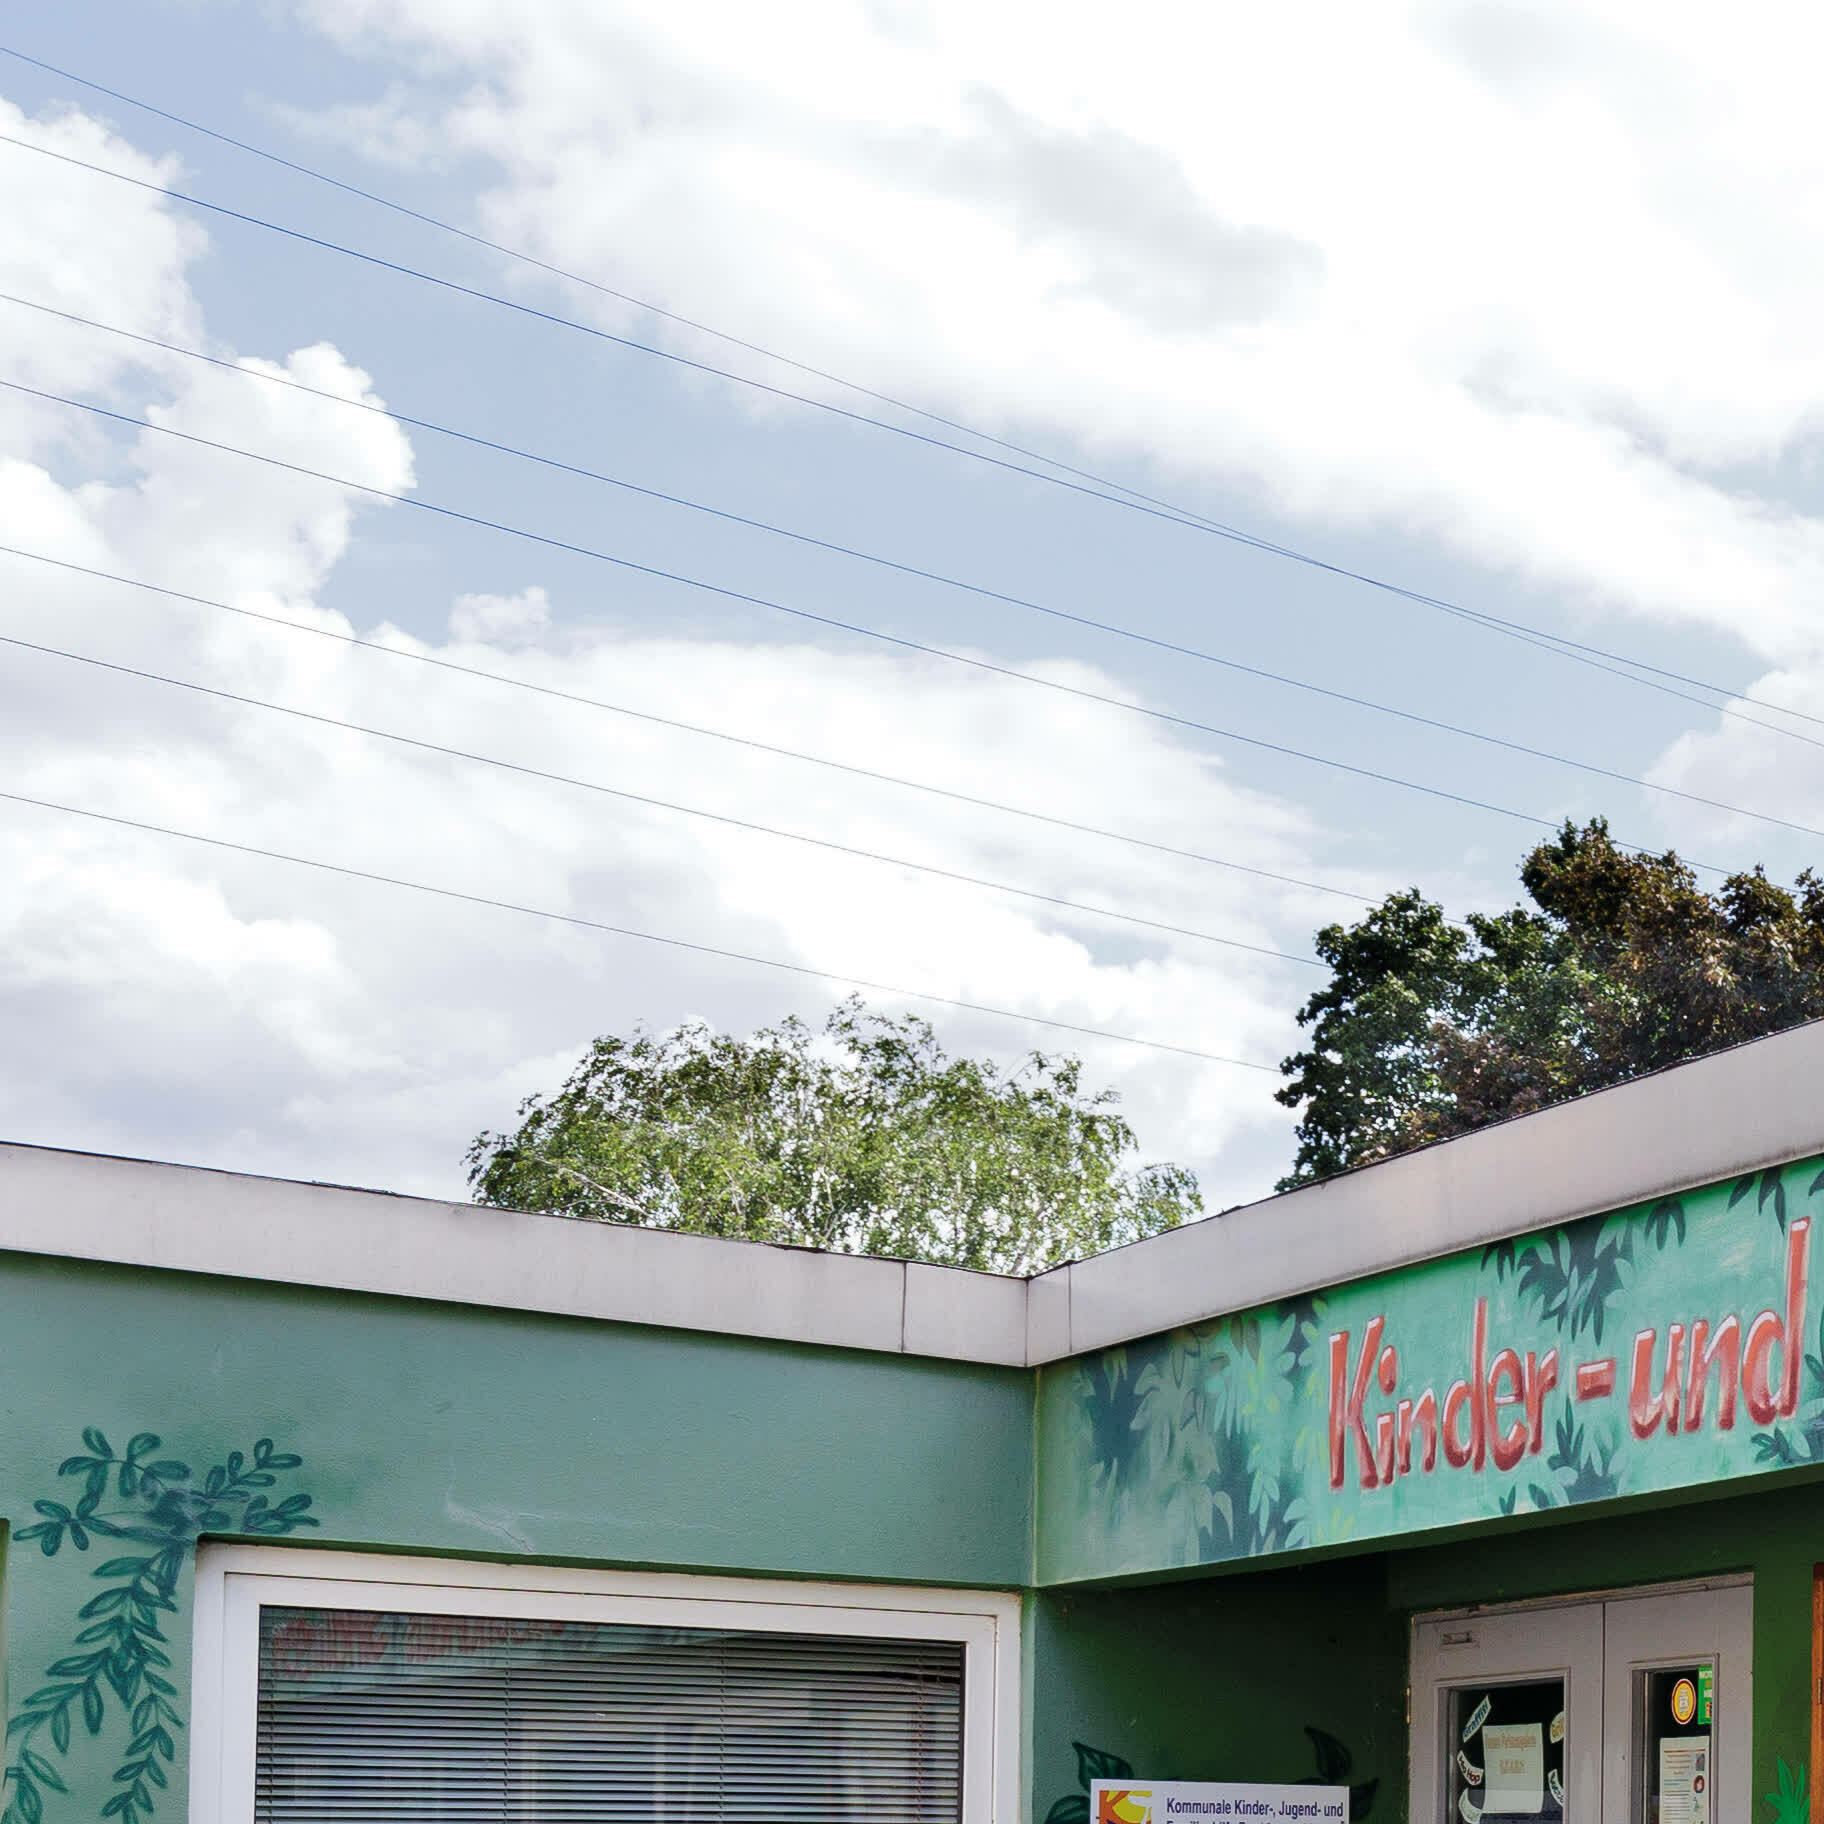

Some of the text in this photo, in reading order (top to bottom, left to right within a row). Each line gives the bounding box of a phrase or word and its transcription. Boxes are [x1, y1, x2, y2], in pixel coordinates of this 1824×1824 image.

[1166, 1798, 1344, 1820] Kommunale Kinder-, Jugend- und
